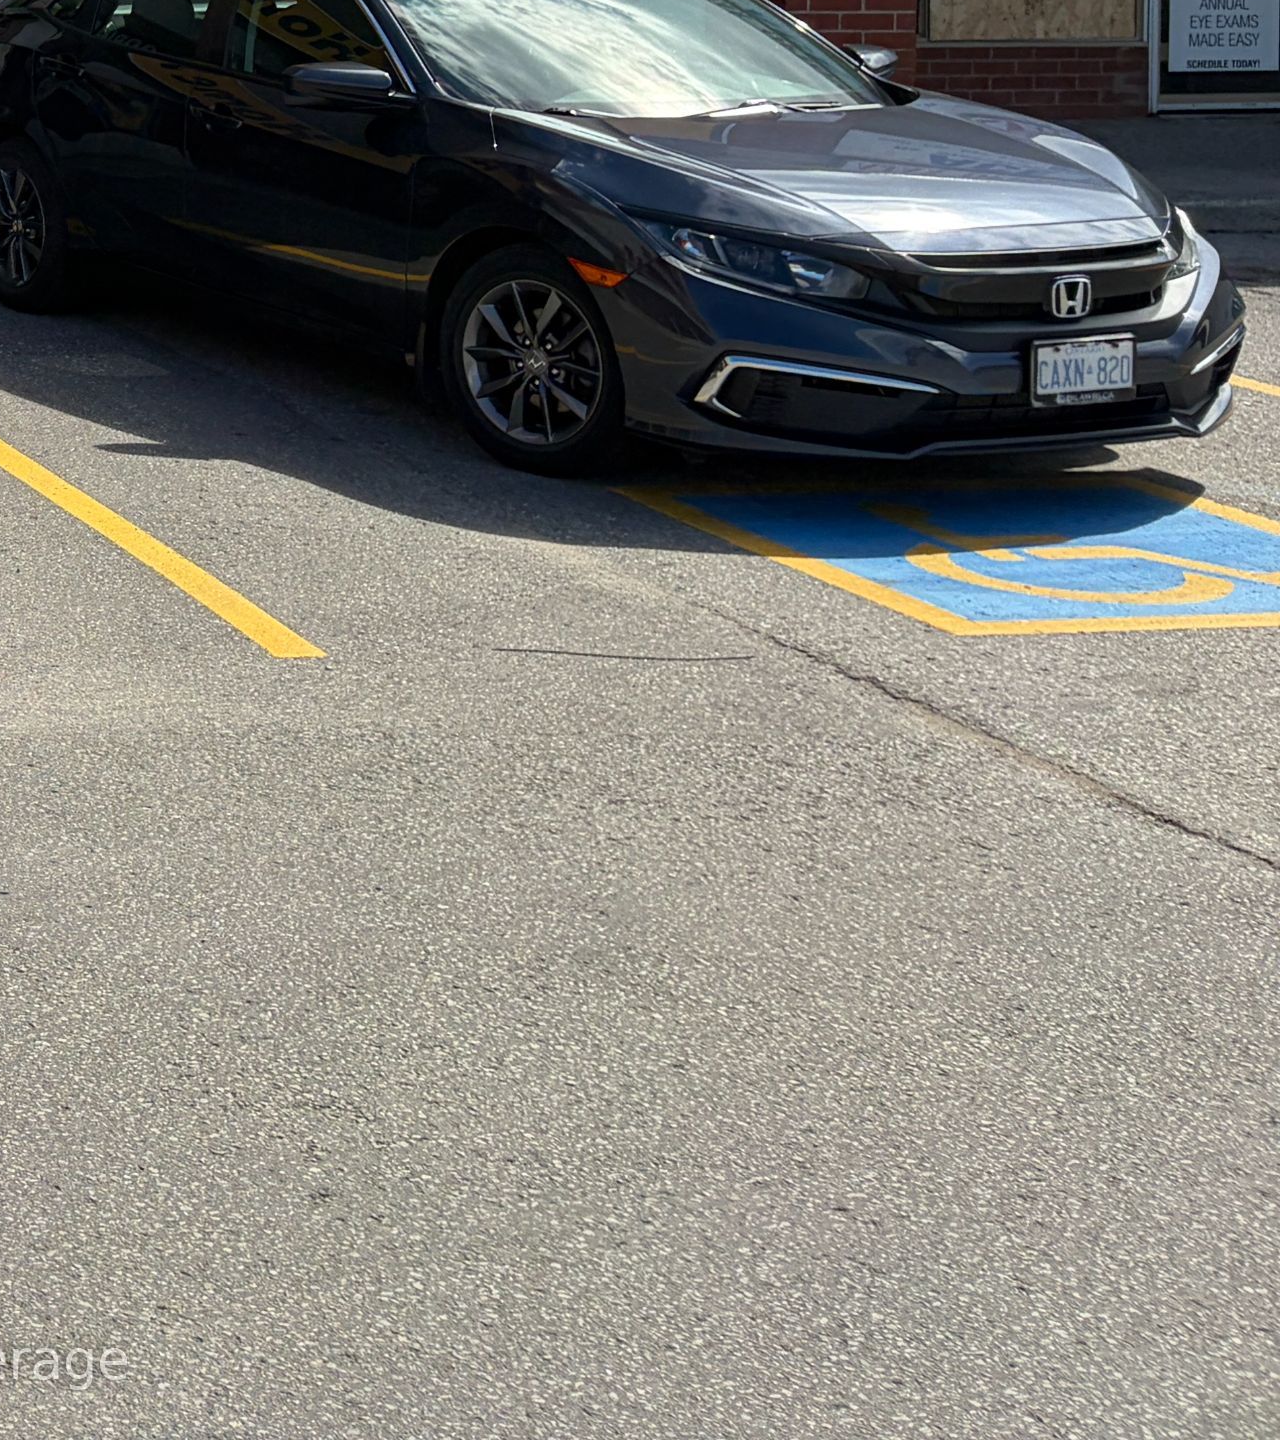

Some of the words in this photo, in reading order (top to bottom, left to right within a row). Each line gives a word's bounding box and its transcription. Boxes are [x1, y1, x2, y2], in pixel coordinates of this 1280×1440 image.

[1190, 15, 1212, 29] EYE
[1216, 14, 1260, 28] EXAMS
[1188, 33, 1225, 47] MADE
[1228, 32, 1260, 47] EASY
[1186, 60, 1229, 69] SCHEDULE
[1232, 59, 1260, 68] TODAY!
